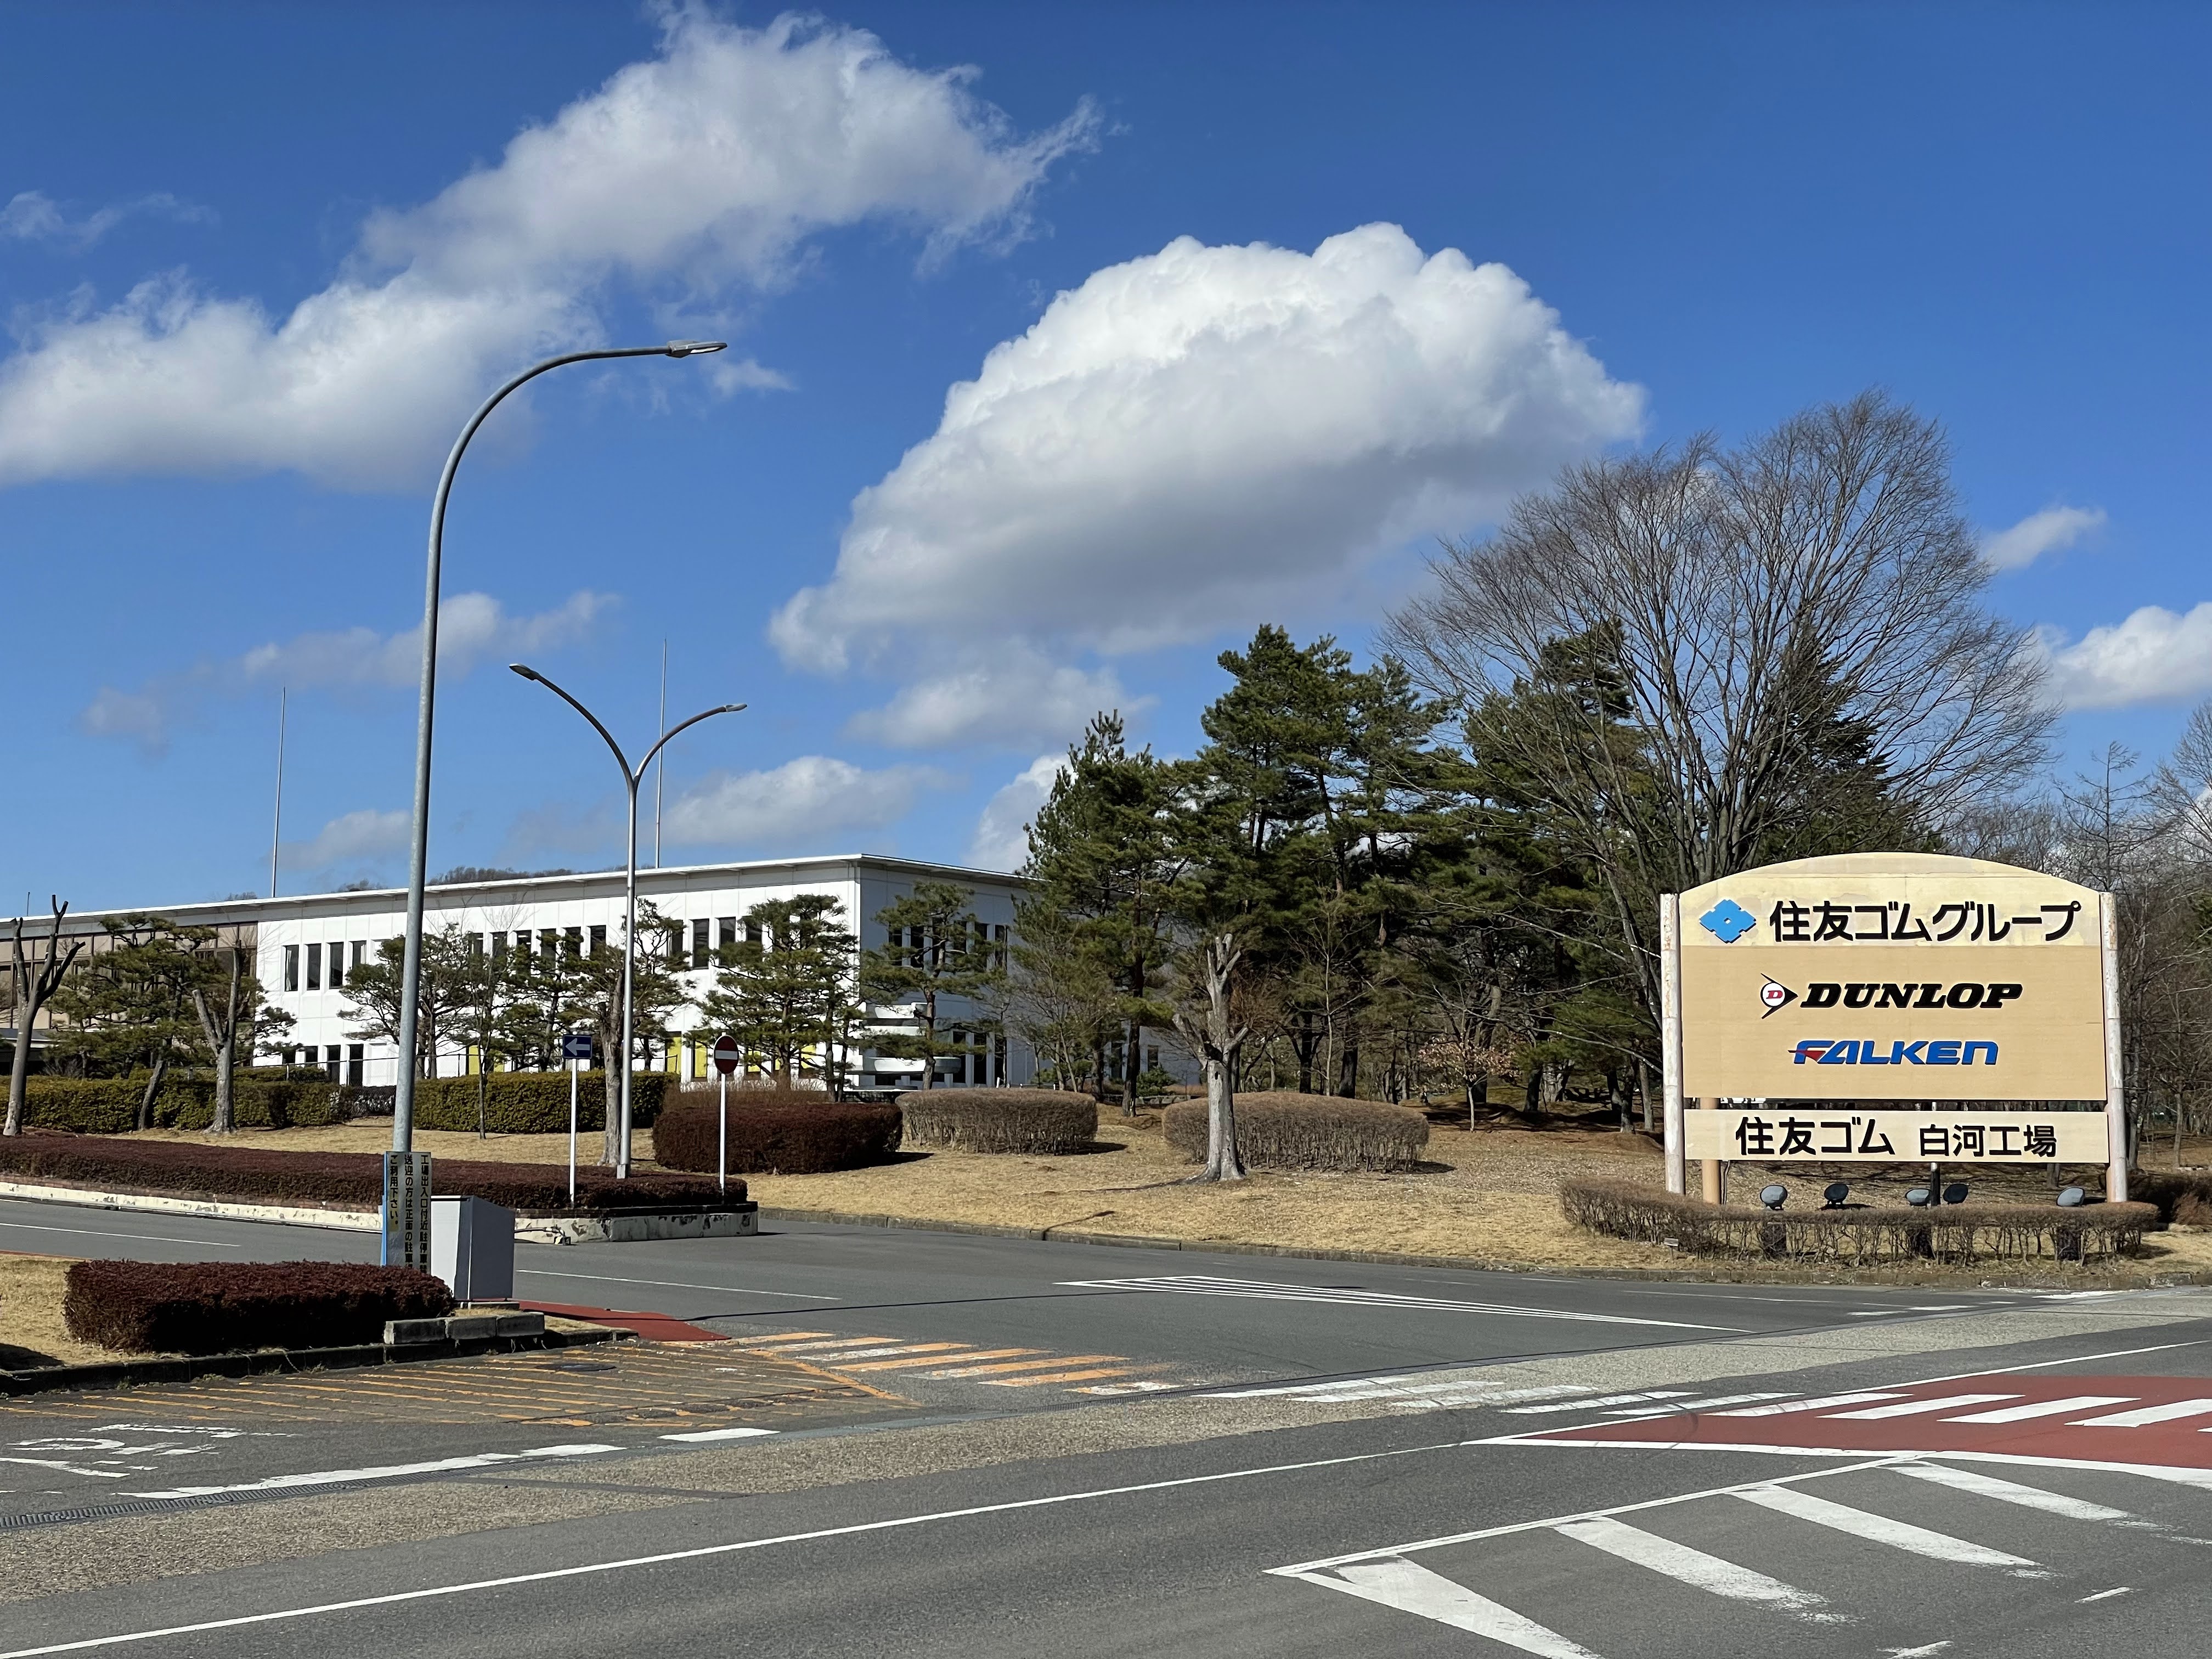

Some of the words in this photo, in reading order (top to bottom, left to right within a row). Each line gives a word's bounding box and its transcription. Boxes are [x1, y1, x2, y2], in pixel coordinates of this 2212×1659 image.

[1769, 900, 2081, 943] 住友ゴムグループ
[1765, 990, 1784, 1000] D
[1799, 983, 2023, 1008] DUNLOP
[1788, 1040, 1999, 1065] FALKEN
[1735, 1116, 1895, 1156] 住友ゴム
[1920, 1124, 2057, 1158] 白河工場
